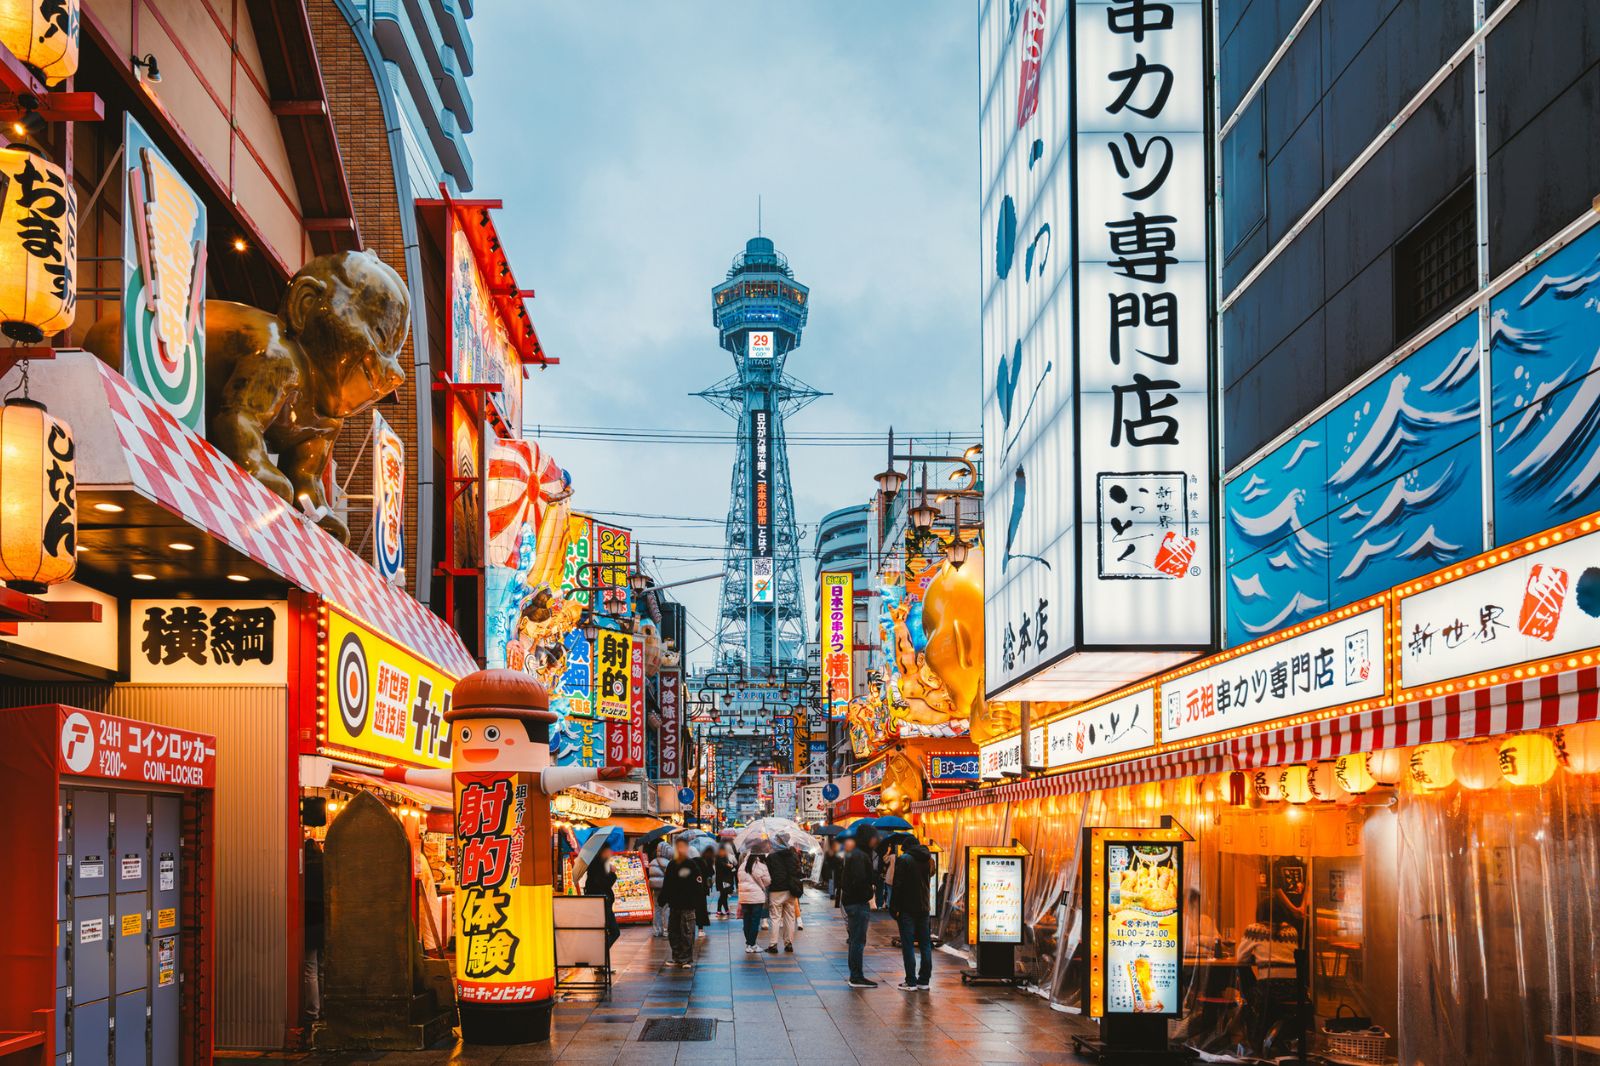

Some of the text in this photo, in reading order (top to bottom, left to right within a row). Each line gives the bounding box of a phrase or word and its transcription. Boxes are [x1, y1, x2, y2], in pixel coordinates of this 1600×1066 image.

[1104, 0, 1179, 447] 串カツ専門店
[753, 335, 769, 346] 29
[1155, 486, 1177, 529] 新世界
[601, 531, 628, 555] 24
[141, 606, 277, 666] 横綱
[831, 586, 844, 652] 日本一の串かつ
[1003, 598, 1049, 673] 総本店
[1409, 604, 1510, 662] 新世界
[378, 665, 409, 705] 新世界
[602, 634, 629, 702] 射的
[632, 648, 642, 679] 名物
[1186, 647, 1334, 722] 元祖串カツ専門店
[374, 700, 407, 738] 遊技場
[601, 707, 628, 717] チャンピオン
[632, 700, 642, 761] てっちり
[99, 719, 216, 764] 24H コインロッカー
[143, 760, 204, 786] COIN-LOCKER
[459, 782, 520, 979] 射的体験
[1153, 939, 1176, 948] 23:30
[475, 985, 536, 1001] チャンピオン
